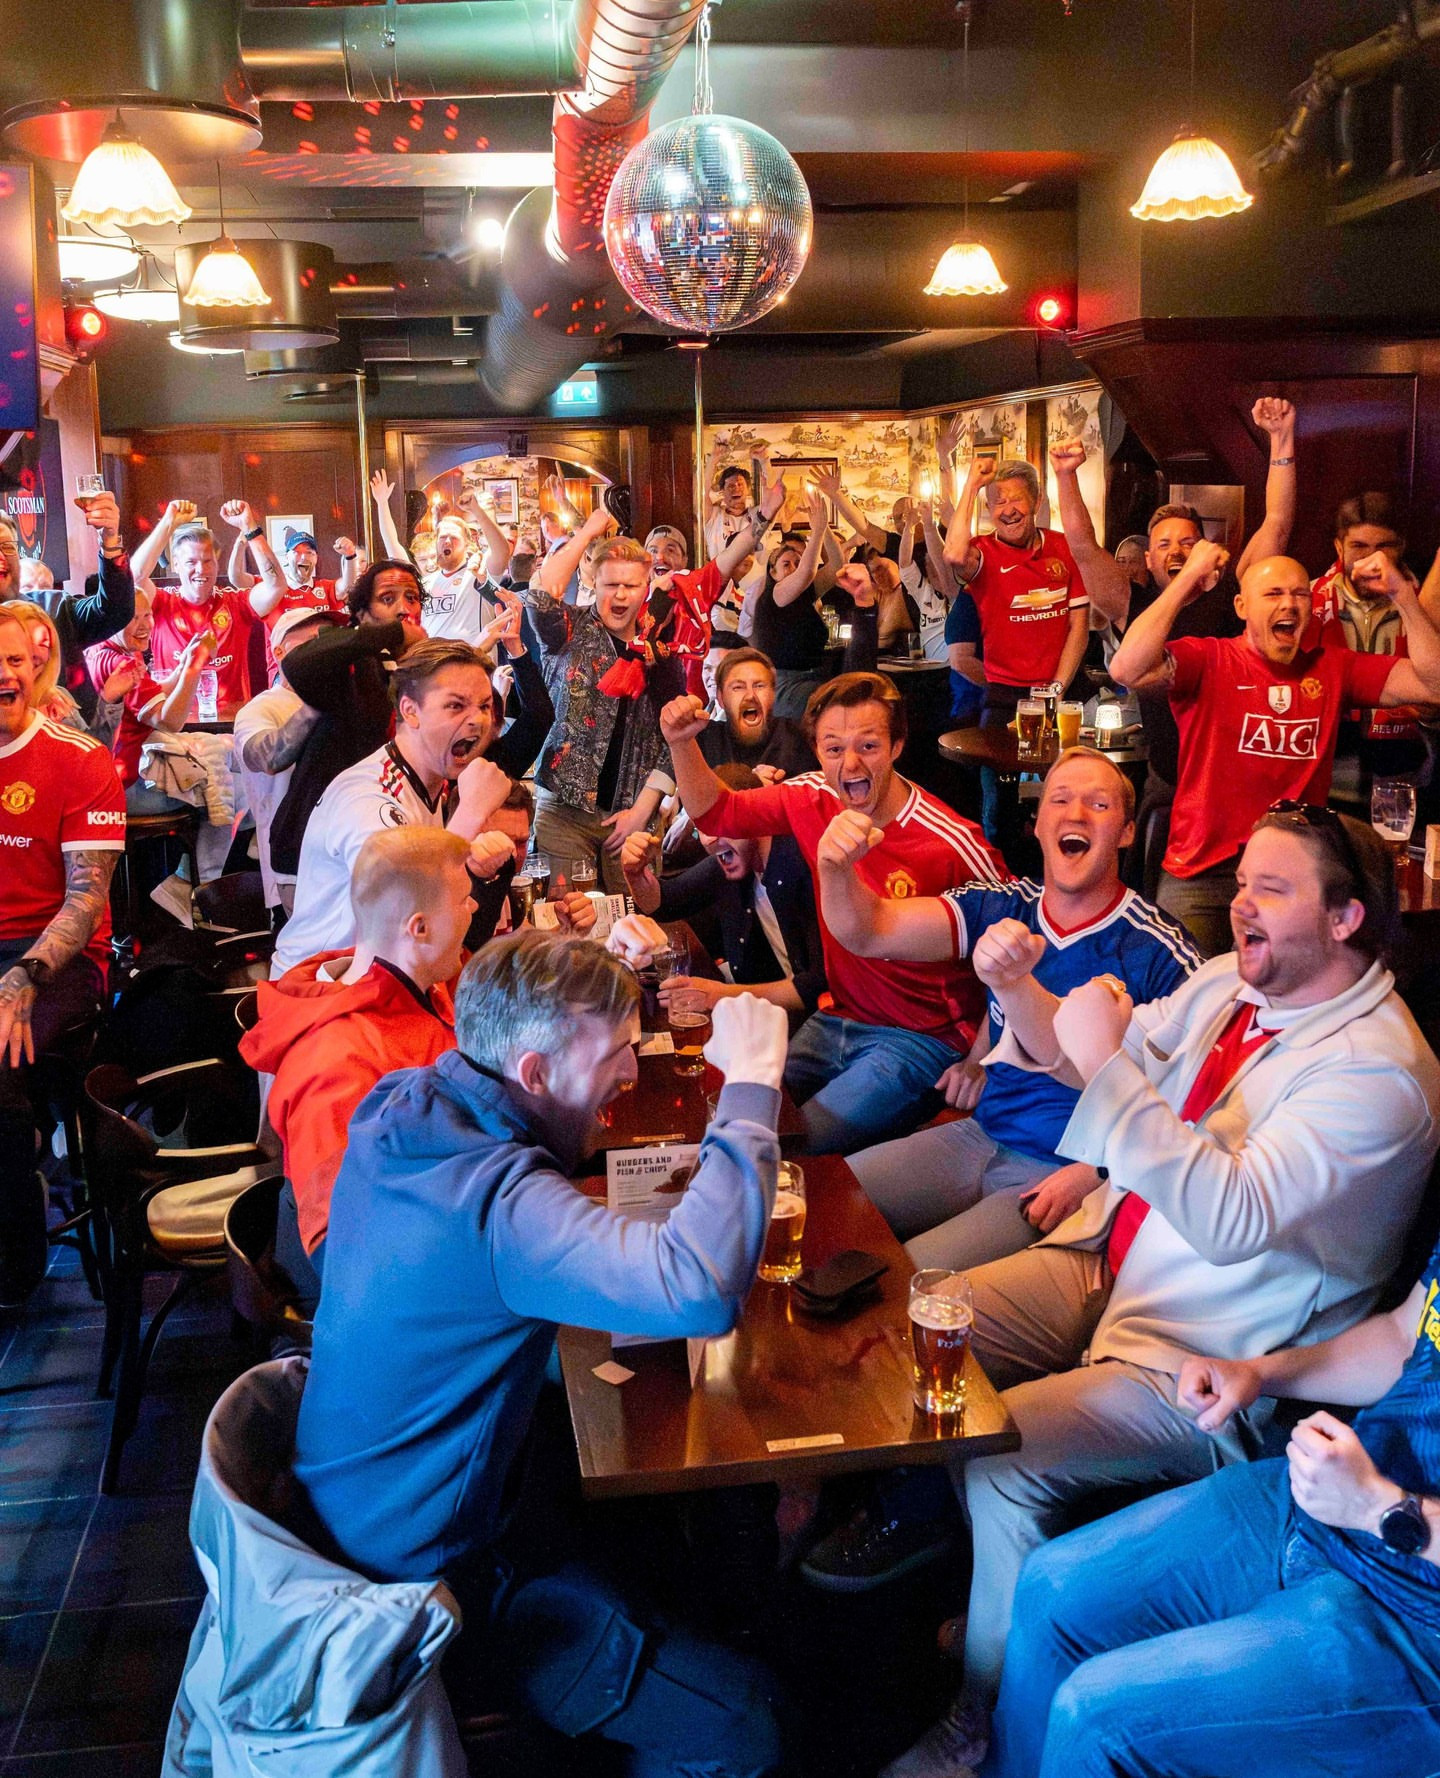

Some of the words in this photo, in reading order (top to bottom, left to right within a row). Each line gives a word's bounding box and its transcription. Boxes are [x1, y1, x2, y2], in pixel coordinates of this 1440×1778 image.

[8, 496, 45, 515] SCOTSMAN
[423, 596, 453, 614] AIG
[1244, 719, 1313, 756] AIG
[616, 1157, 653, 1167] BURGERS
[656, 1156, 672, 1164] AND
[616, 1168, 634, 1176] FISH
[644, 1165, 667, 1174] CHIPS
